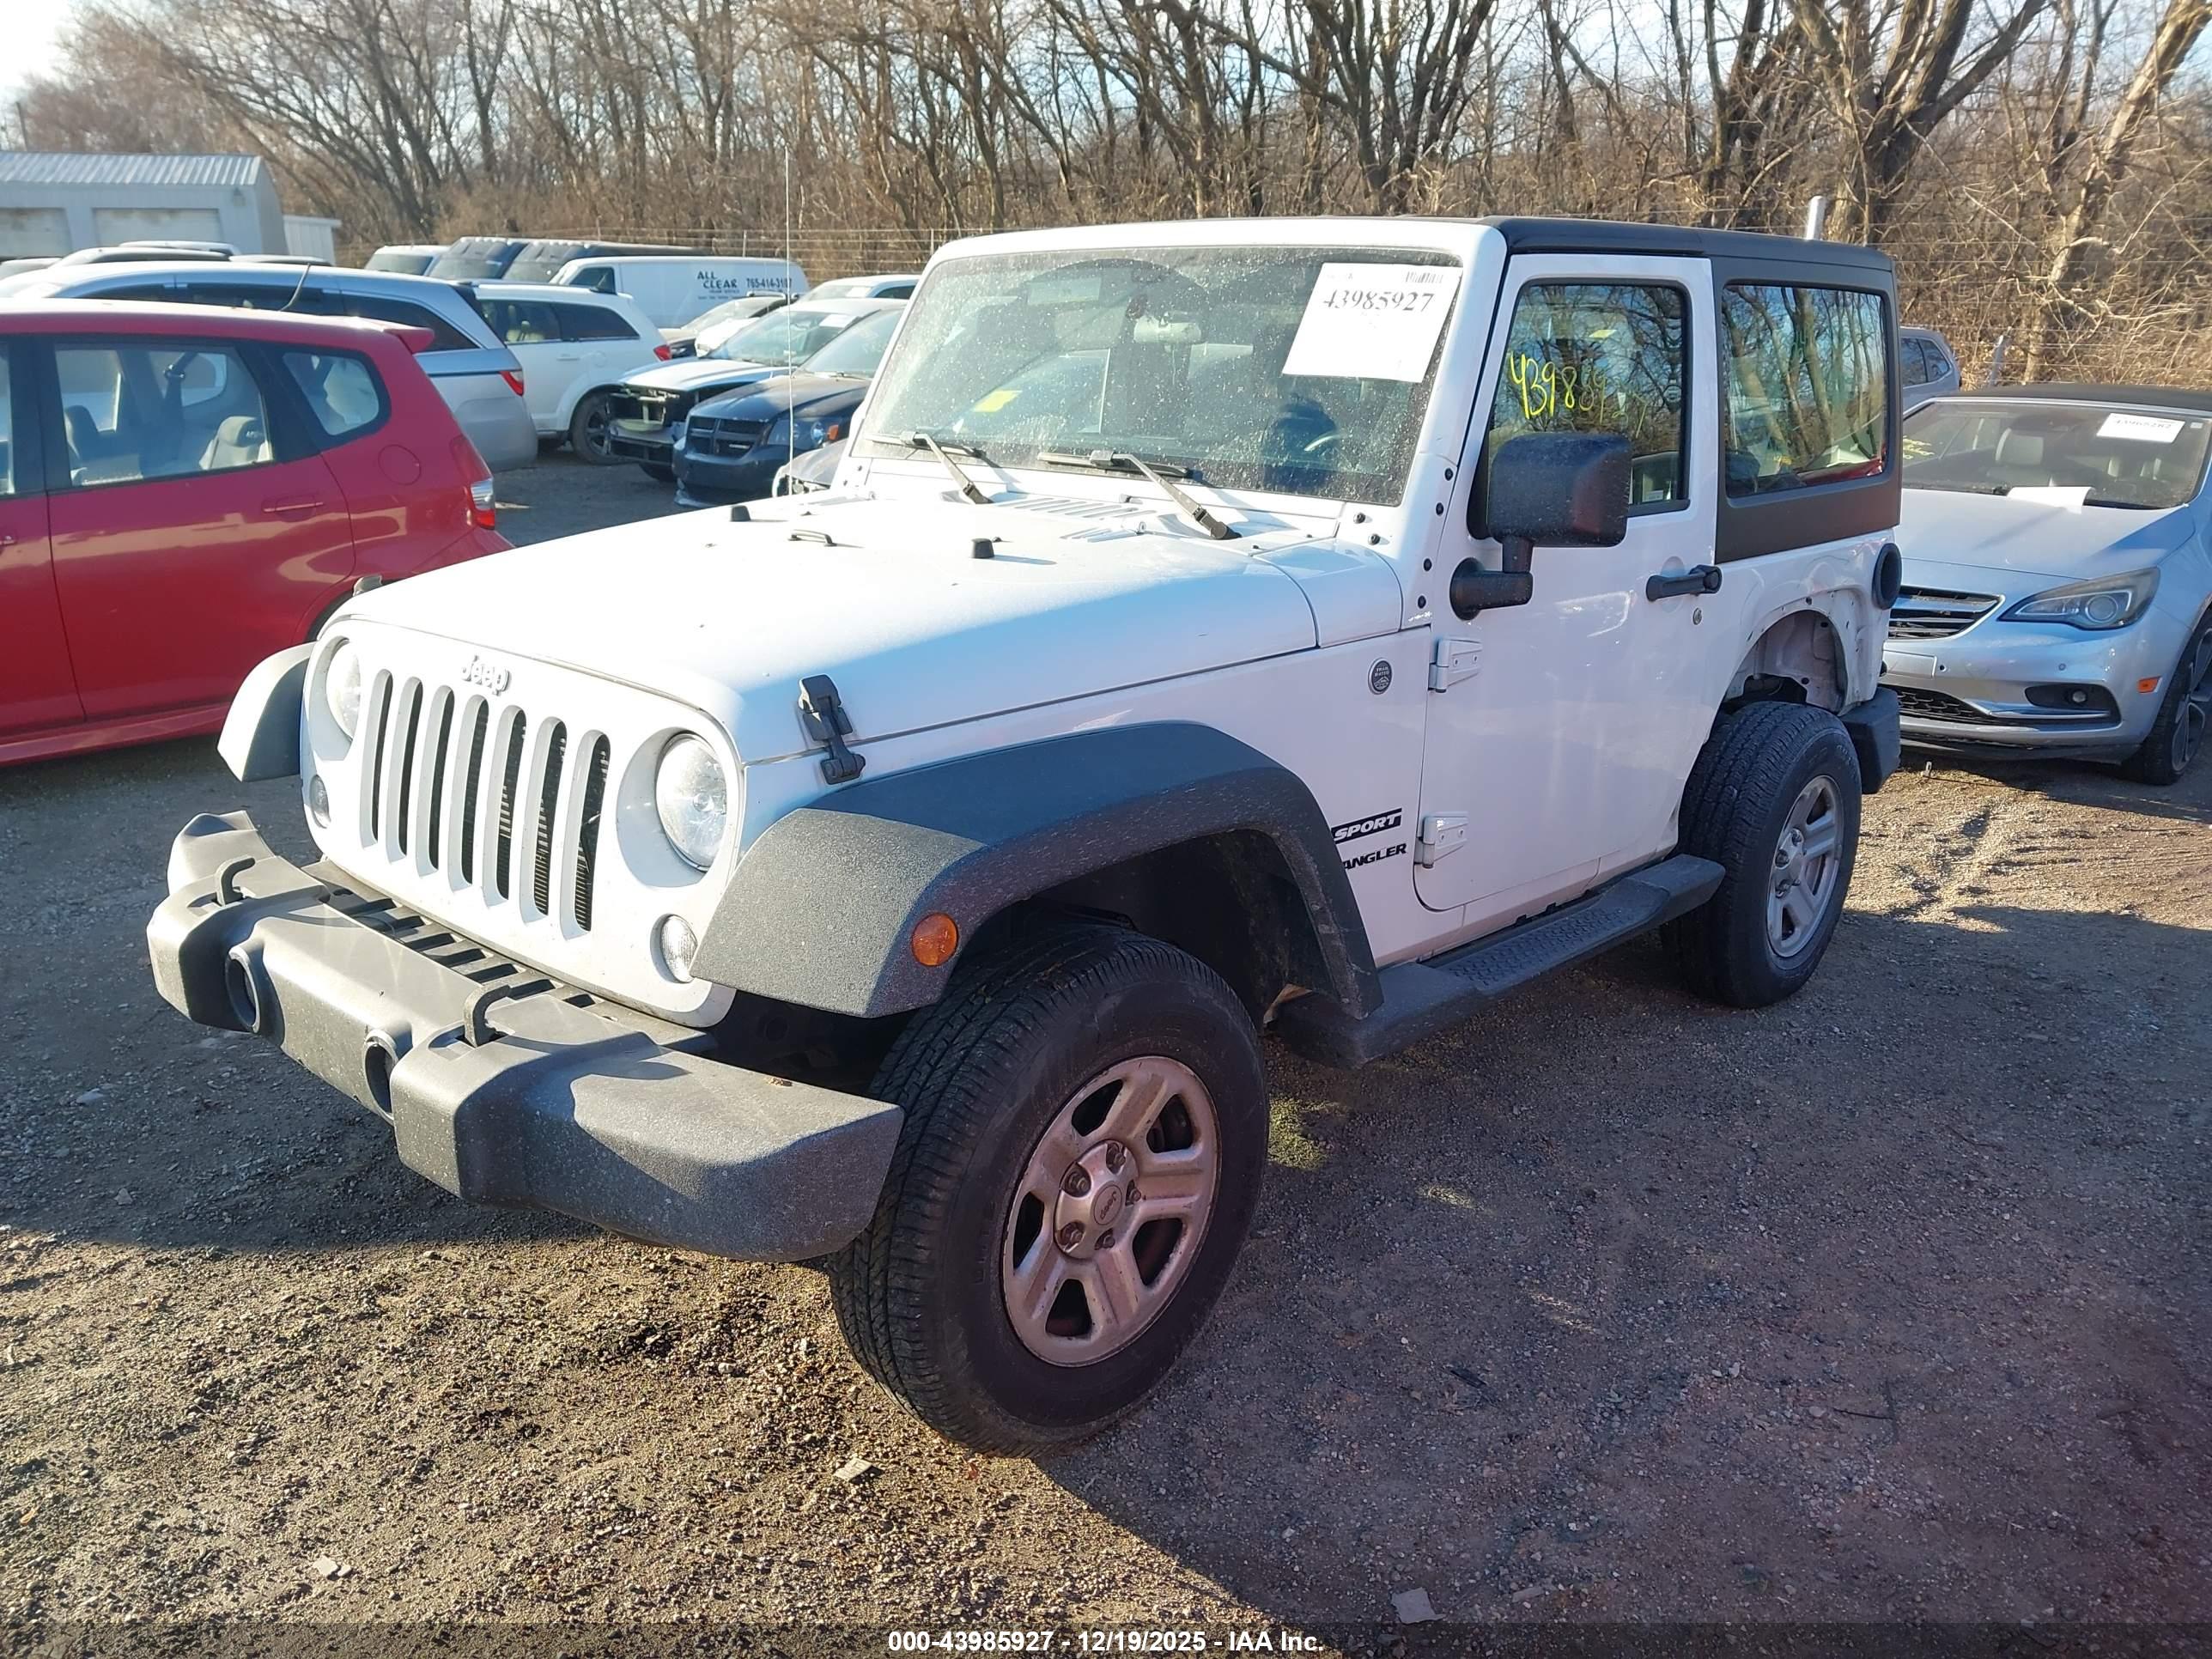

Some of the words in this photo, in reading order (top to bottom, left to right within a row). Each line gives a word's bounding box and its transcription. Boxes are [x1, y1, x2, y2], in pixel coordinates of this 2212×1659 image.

[697, 270, 716, 280] ALL
[703, 278, 738, 289] CLEAR
[1322, 289, 1435, 313] 43985927
[461, 654, 513, 696] Jeep
[1334, 812, 1403, 841] SPORT
[1342, 843, 1407, 870] ANGLER
[1100, 1191, 1117, 1219] Jeep
